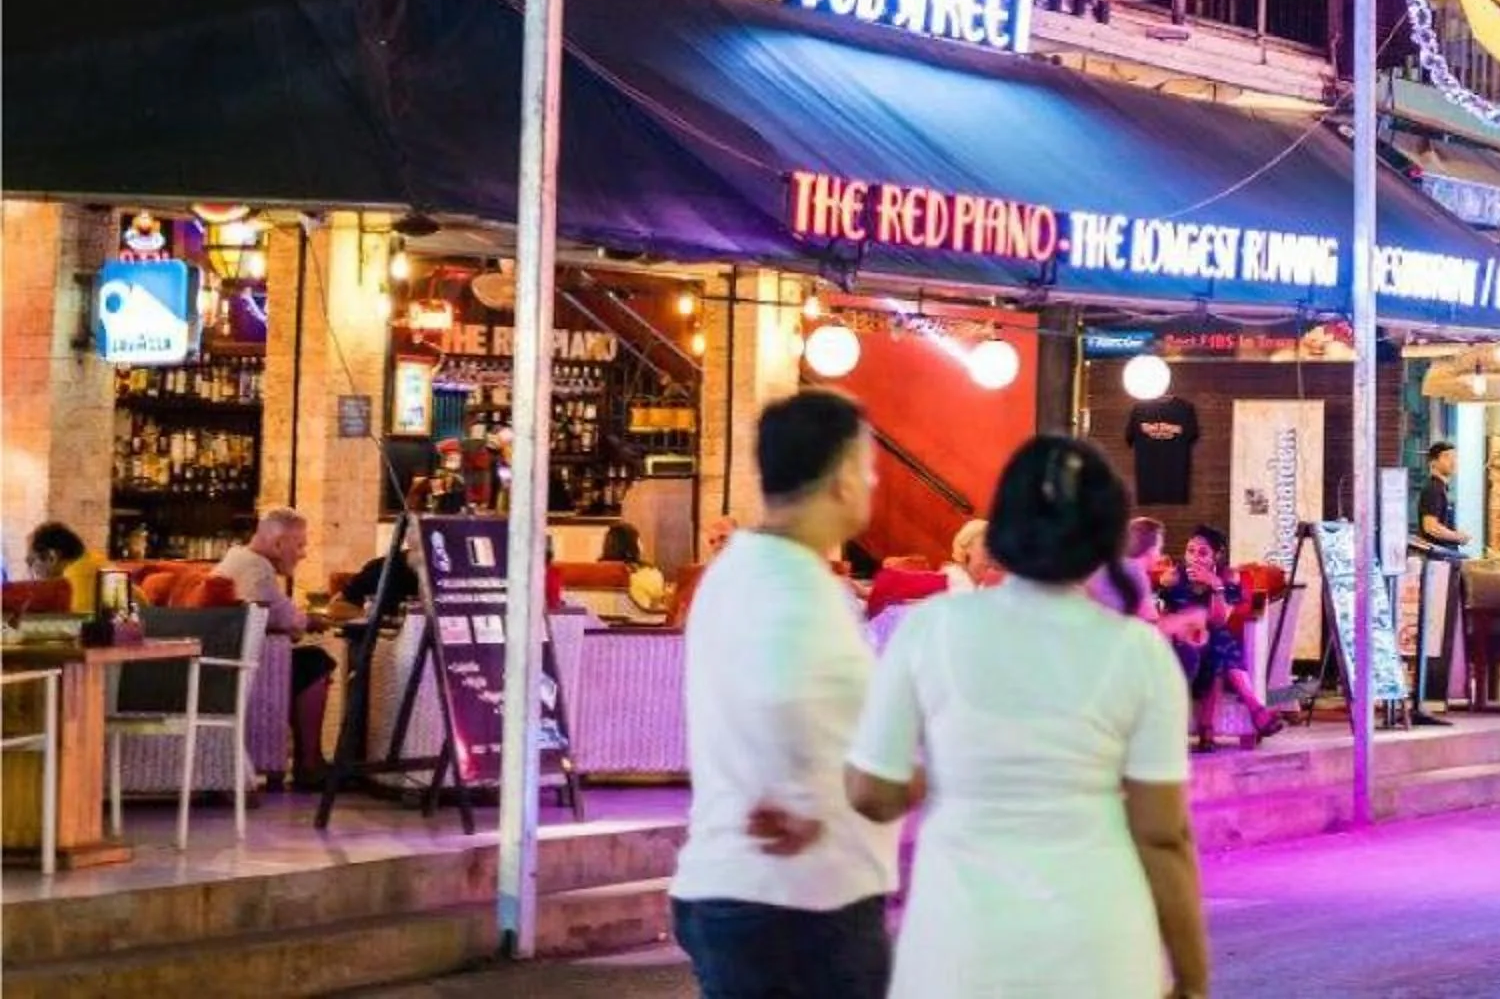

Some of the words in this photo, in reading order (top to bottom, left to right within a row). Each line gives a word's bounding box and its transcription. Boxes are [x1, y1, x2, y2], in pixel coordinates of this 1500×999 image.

[790, 171, 868, 240] THE
[877, 183, 949, 246] RED
[952, 194, 1058, 262] PIANO
[1068, 209, 1129, 271] THE
